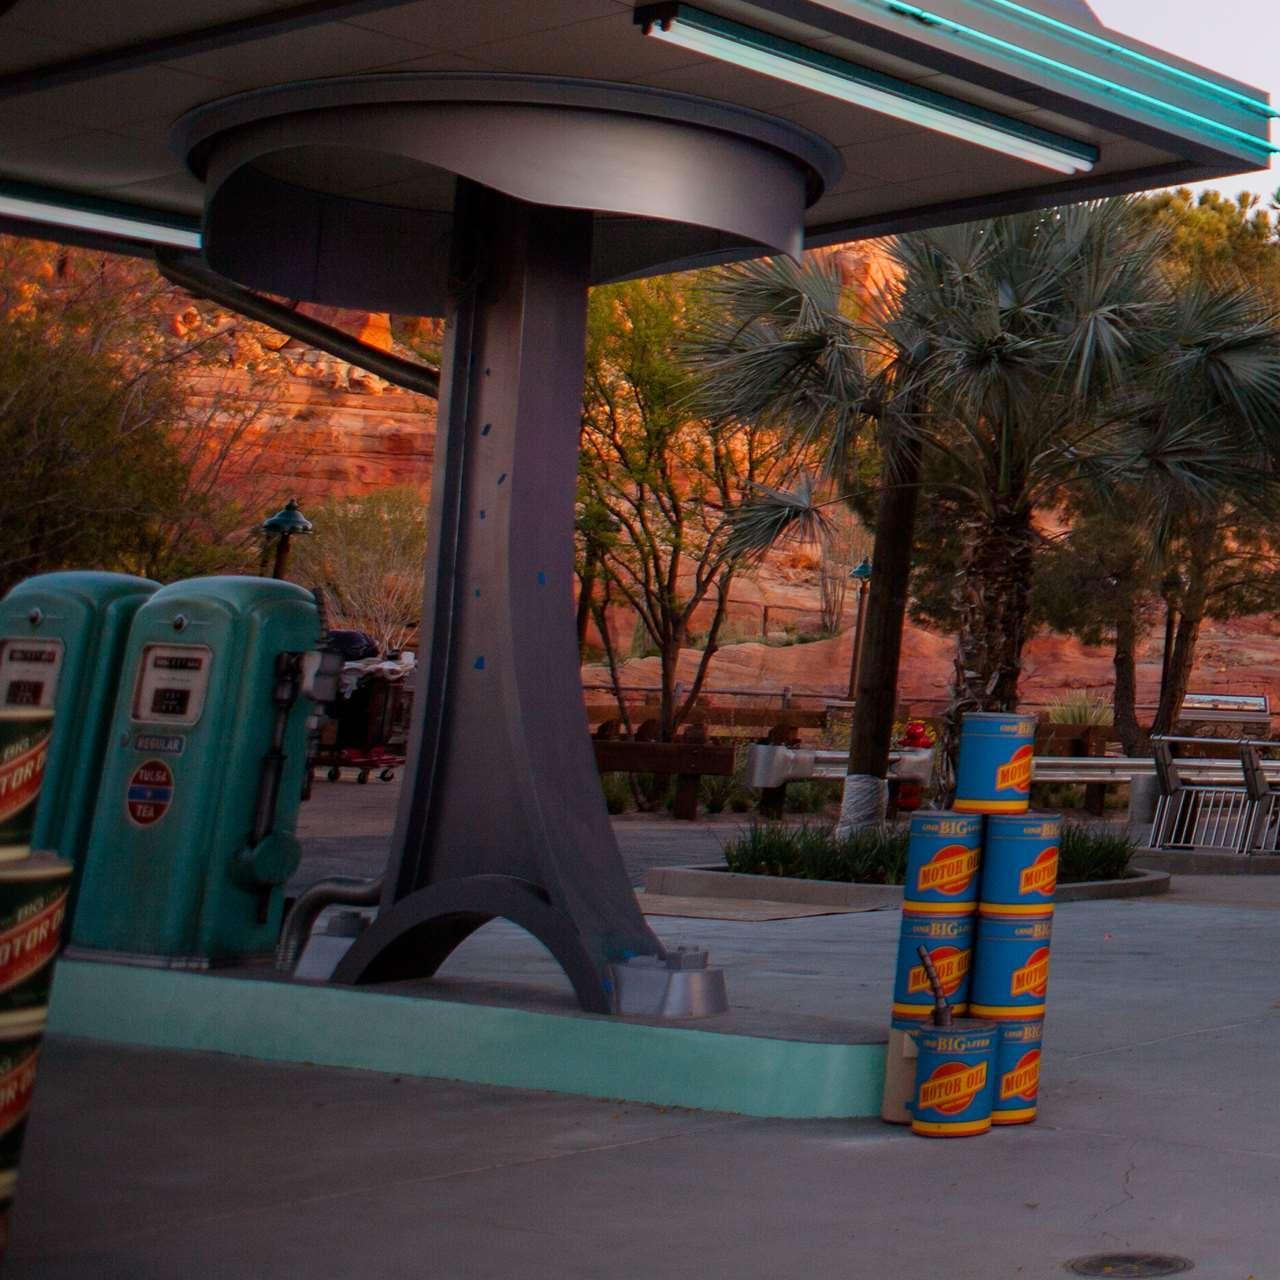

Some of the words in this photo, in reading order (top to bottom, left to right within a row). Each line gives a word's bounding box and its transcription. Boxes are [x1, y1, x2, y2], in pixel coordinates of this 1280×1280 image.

[137, 735, 180, 754] REGULAR
[138, 768, 168, 783] TULSA
[136, 804, 155, 818] TEA
[939, 820, 967, 836] BIG
[921, 861, 963, 883] MOTOR
[930, 922, 958, 937] BIG
[938, 1037, 966, 1052] BIG
[921, 1079, 961, 1101] MOTOR
[966, 1070, 985, 1089] OIL
